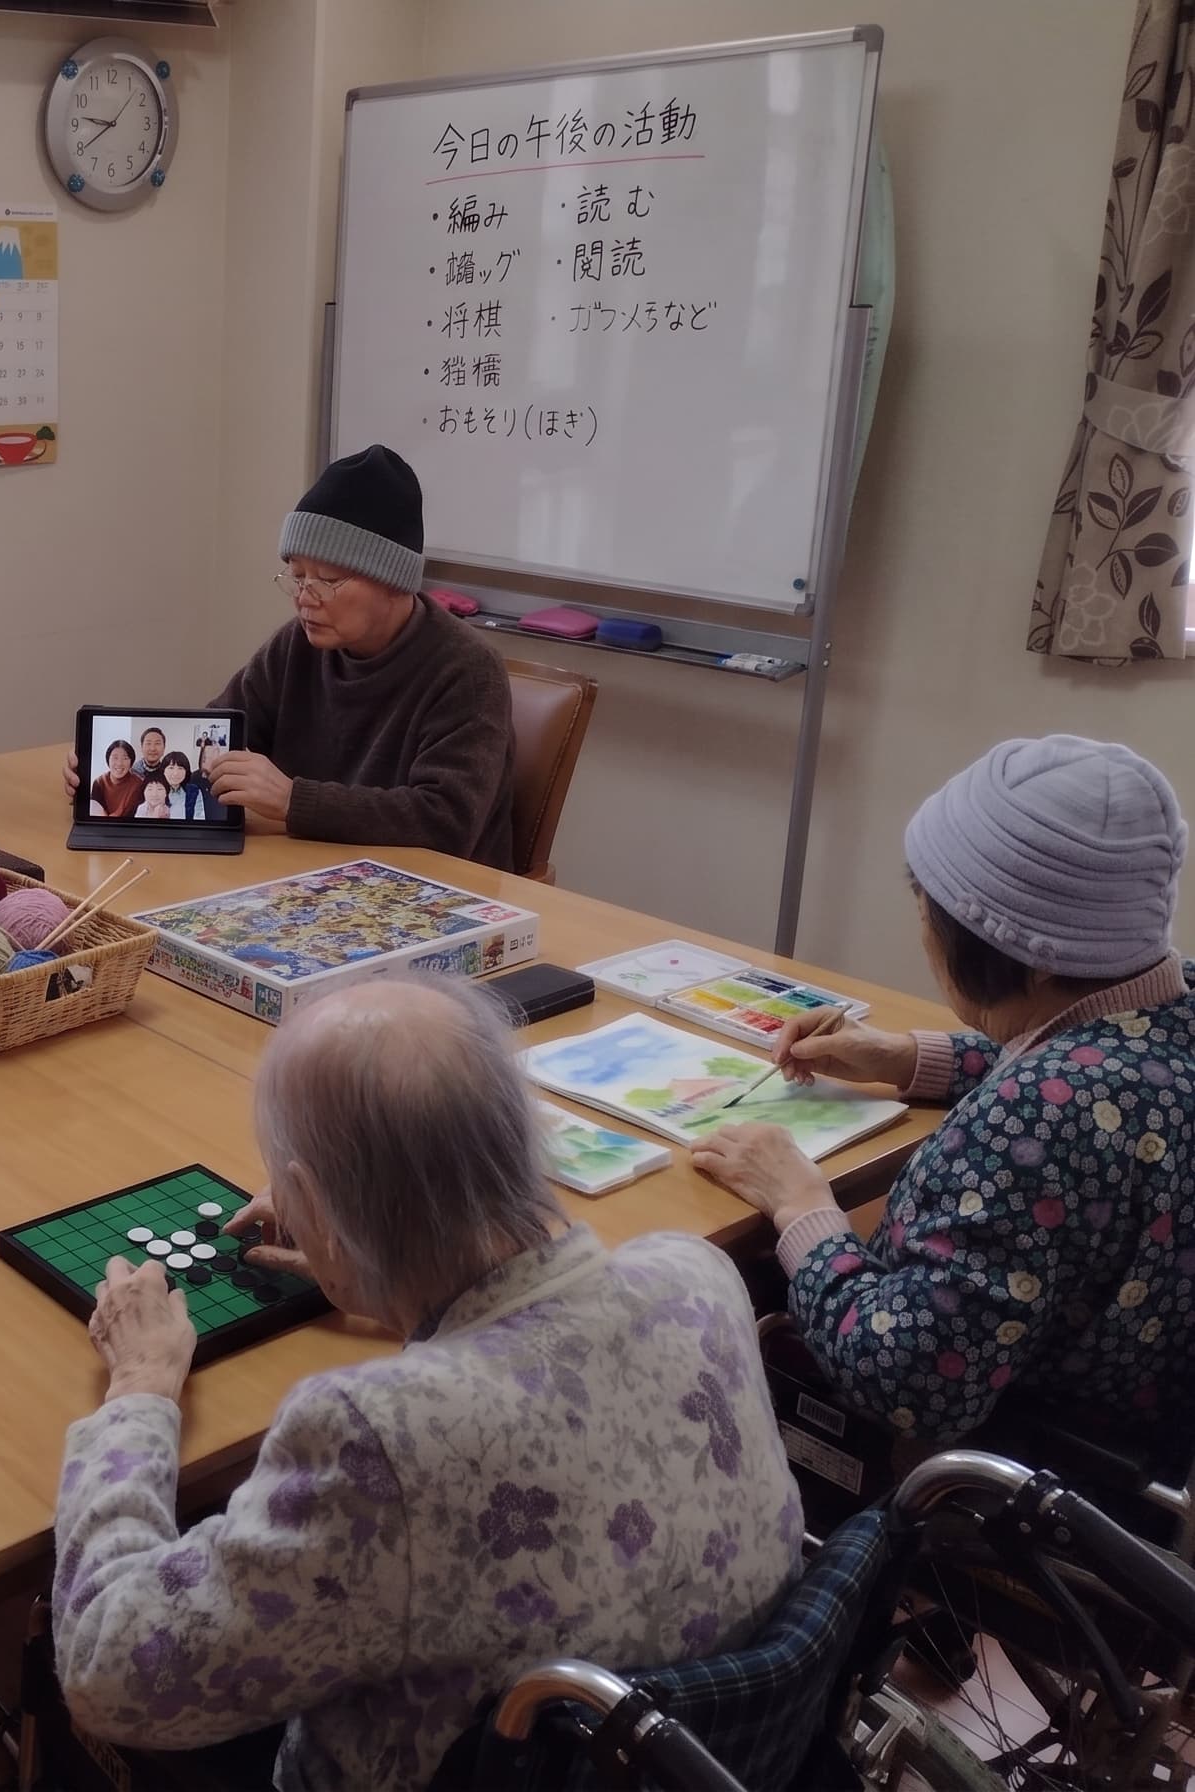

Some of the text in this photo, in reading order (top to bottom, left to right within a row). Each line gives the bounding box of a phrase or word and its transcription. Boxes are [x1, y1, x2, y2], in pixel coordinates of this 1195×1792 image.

[90, 76, 99, 90] 11
[107, 69, 117, 84] 12
[76, 94, 87, 108] 10
[139, 93, 146, 107] 2
[71, 118, 79, 132] 9
[144, 117, 151, 131] 3
[433, 97, 697, 170] 今日の午後の活動
[77, 141, 84, 156] 8
[139, 141, 145, 154] 4
[91, 157, 98, 171] 7
[127, 156, 133, 170] 5
[107, 163, 115, 178] 6
[447, 194, 509, 234] 編み
[441, 300, 502, 339] 将棋
